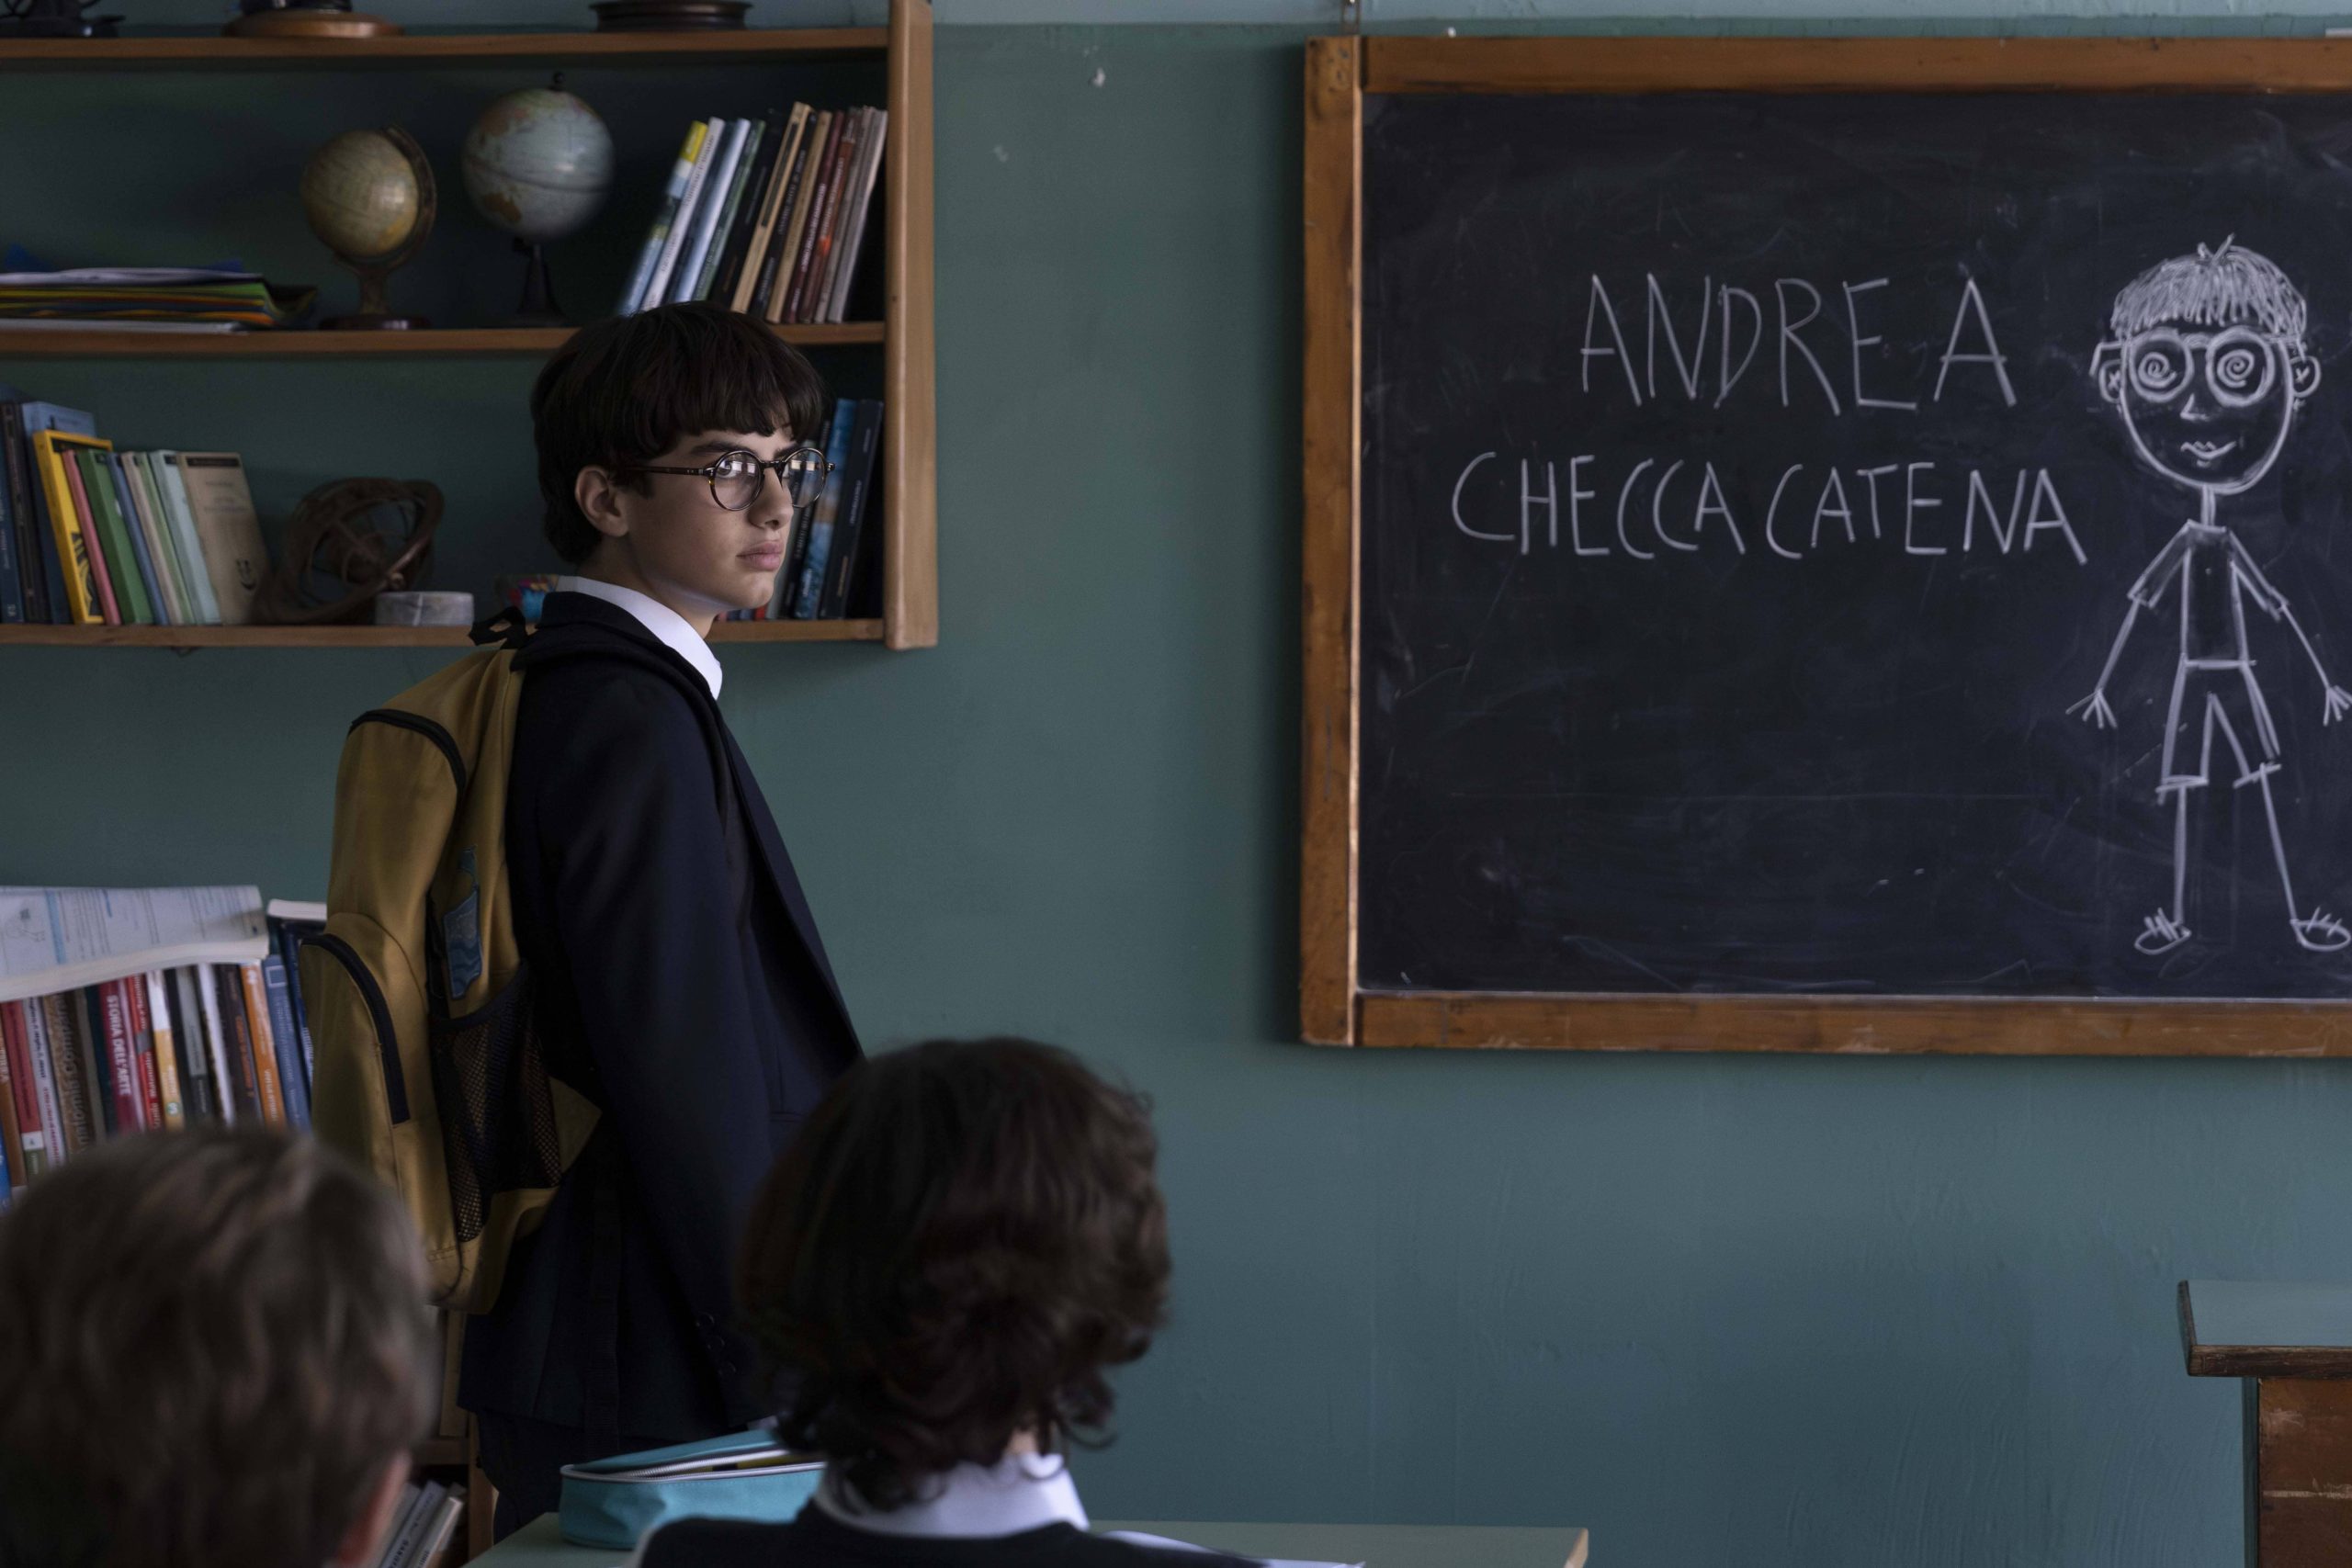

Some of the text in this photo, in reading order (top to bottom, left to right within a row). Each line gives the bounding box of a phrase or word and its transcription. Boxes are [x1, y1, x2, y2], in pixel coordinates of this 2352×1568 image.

[1580, 274, 2016, 415] ANDREA
[106, 993, 131, 1097] STORIA DELL'ARTE
